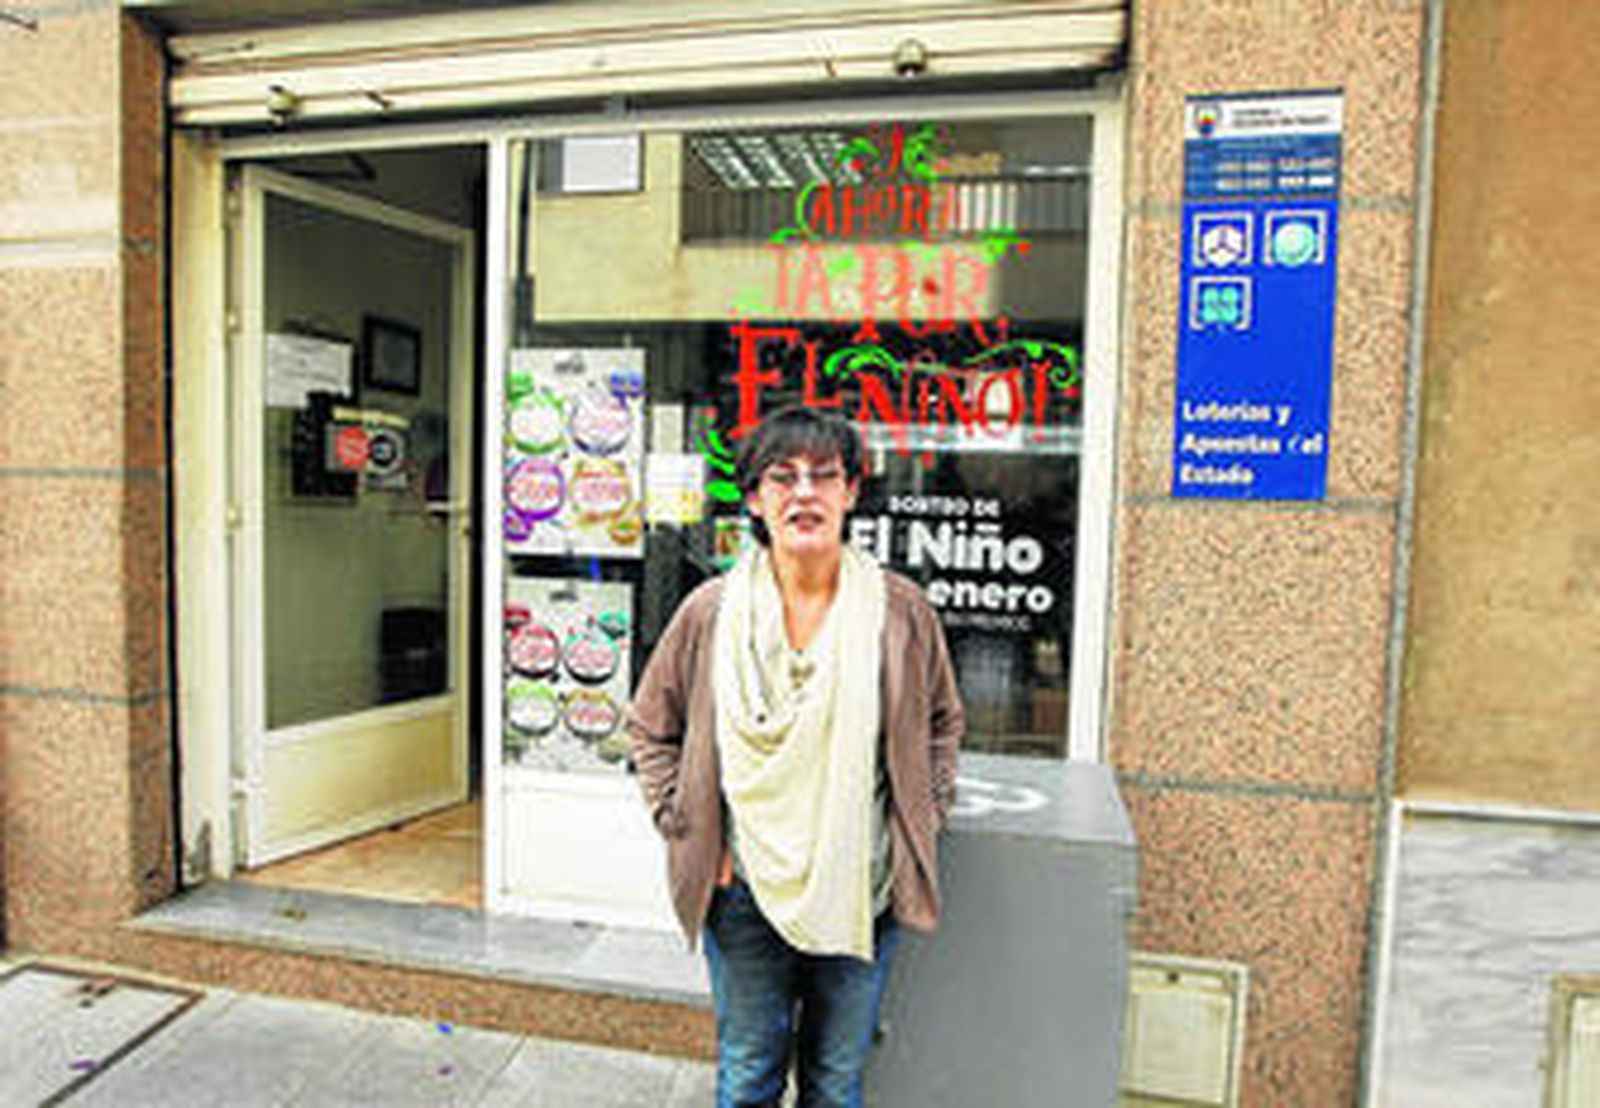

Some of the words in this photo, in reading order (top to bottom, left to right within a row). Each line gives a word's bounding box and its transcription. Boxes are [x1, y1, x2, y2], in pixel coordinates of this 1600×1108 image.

[1276, 404, 1291, 426] y
[1180, 463, 1254, 484] Estado
[973, 499, 1001, 518] DE
[849, 515, 891, 563] El
[906, 520, 1044, 573] Niño
[927, 579, 1054, 613] enero
